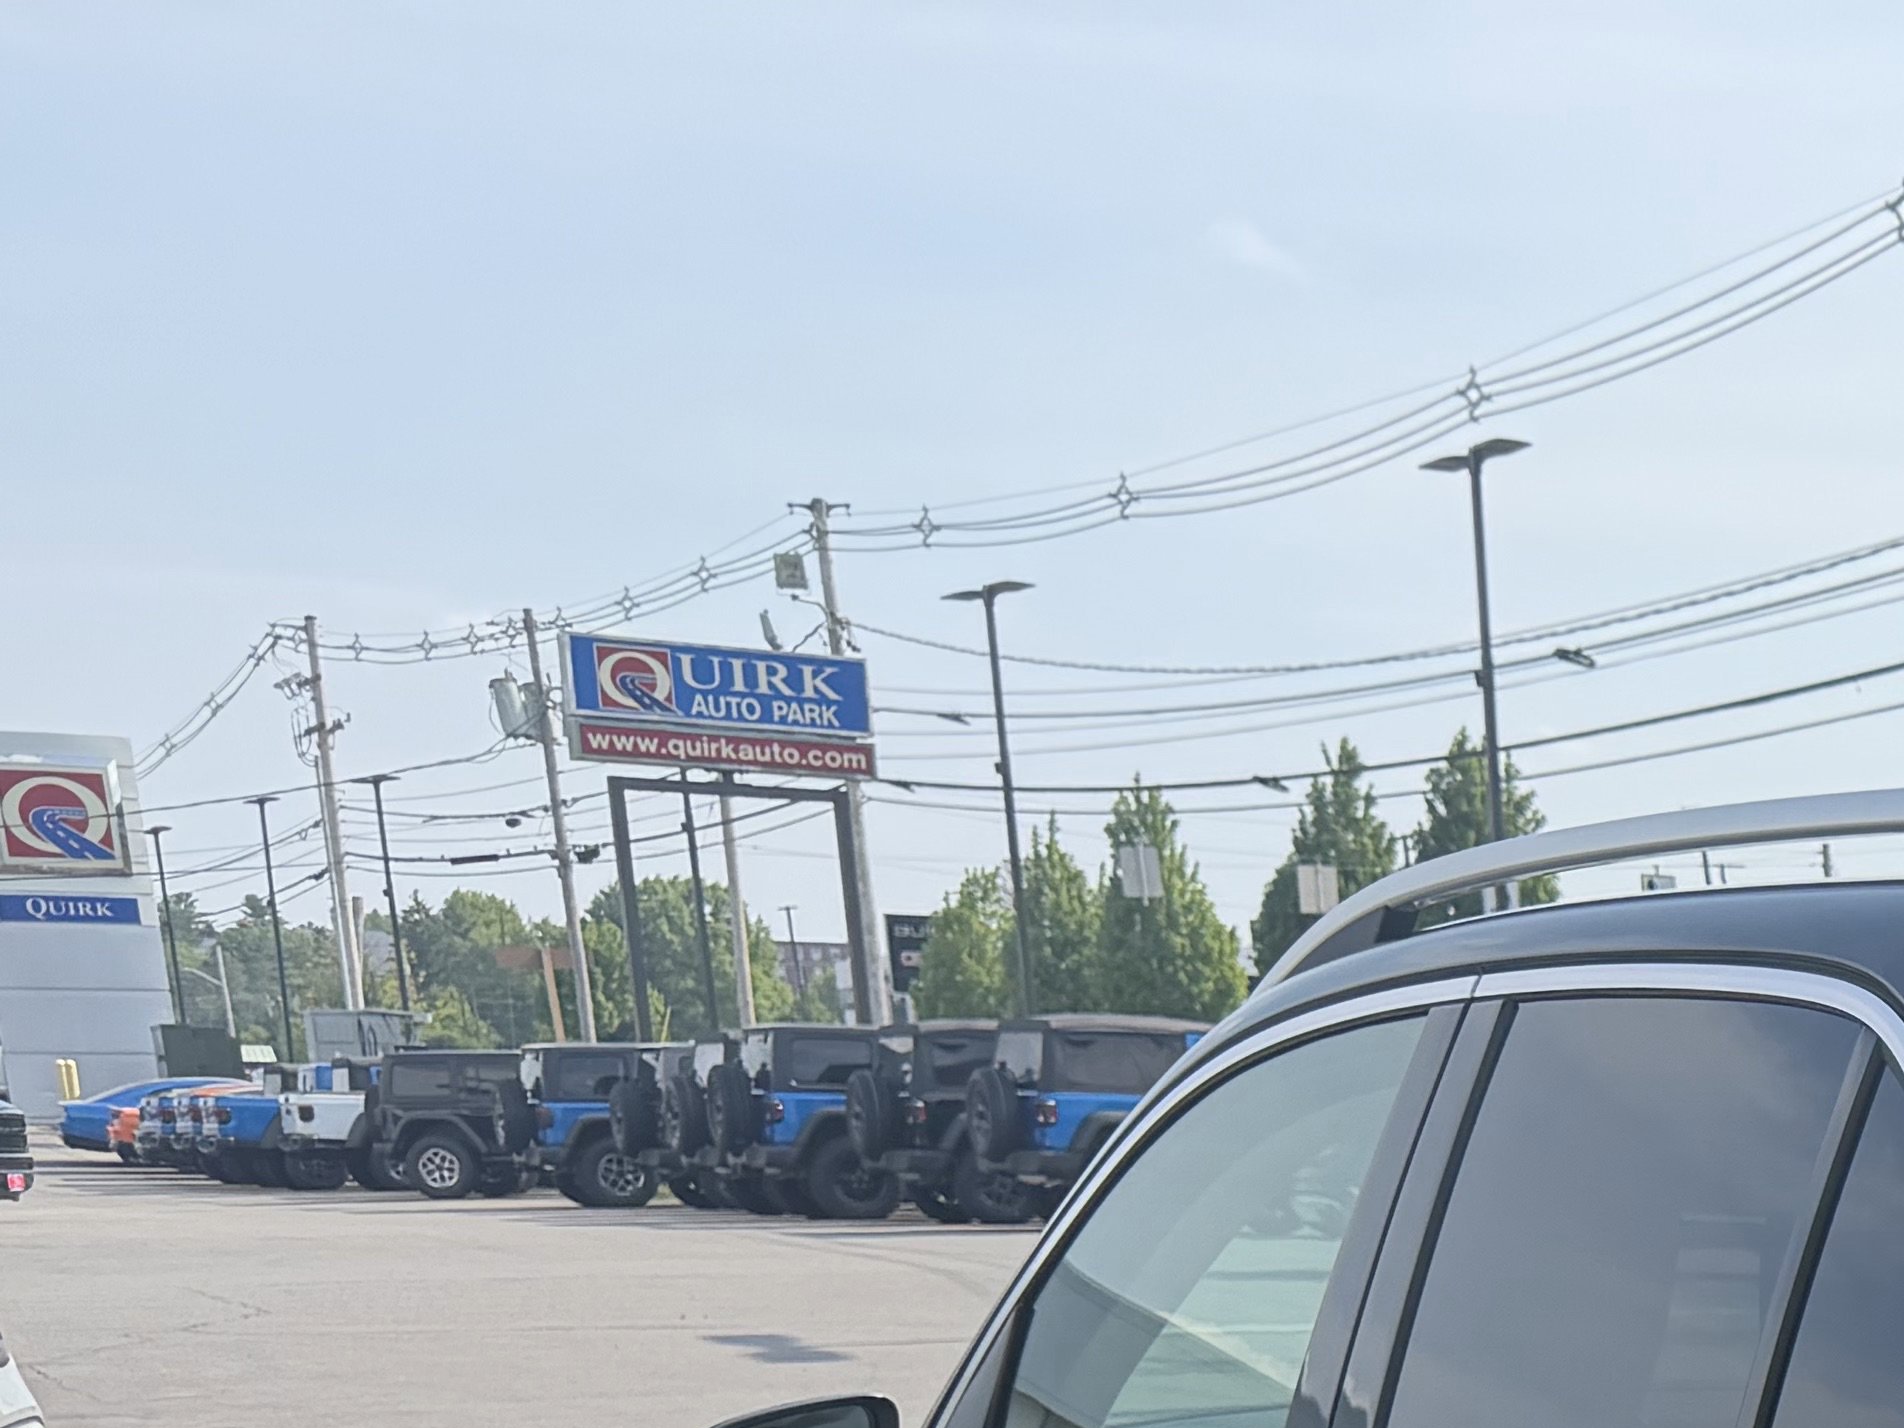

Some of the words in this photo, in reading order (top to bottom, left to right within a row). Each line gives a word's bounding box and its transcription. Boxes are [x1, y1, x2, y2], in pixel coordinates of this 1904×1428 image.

[599, 650, 844, 716] QUIRK
[690, 693, 761, 721] AUTO
[772, 701, 840, 728] PARK
[587, 731, 867, 770] www.quirkauto.com
[25, 896, 114, 920] QUIRK
